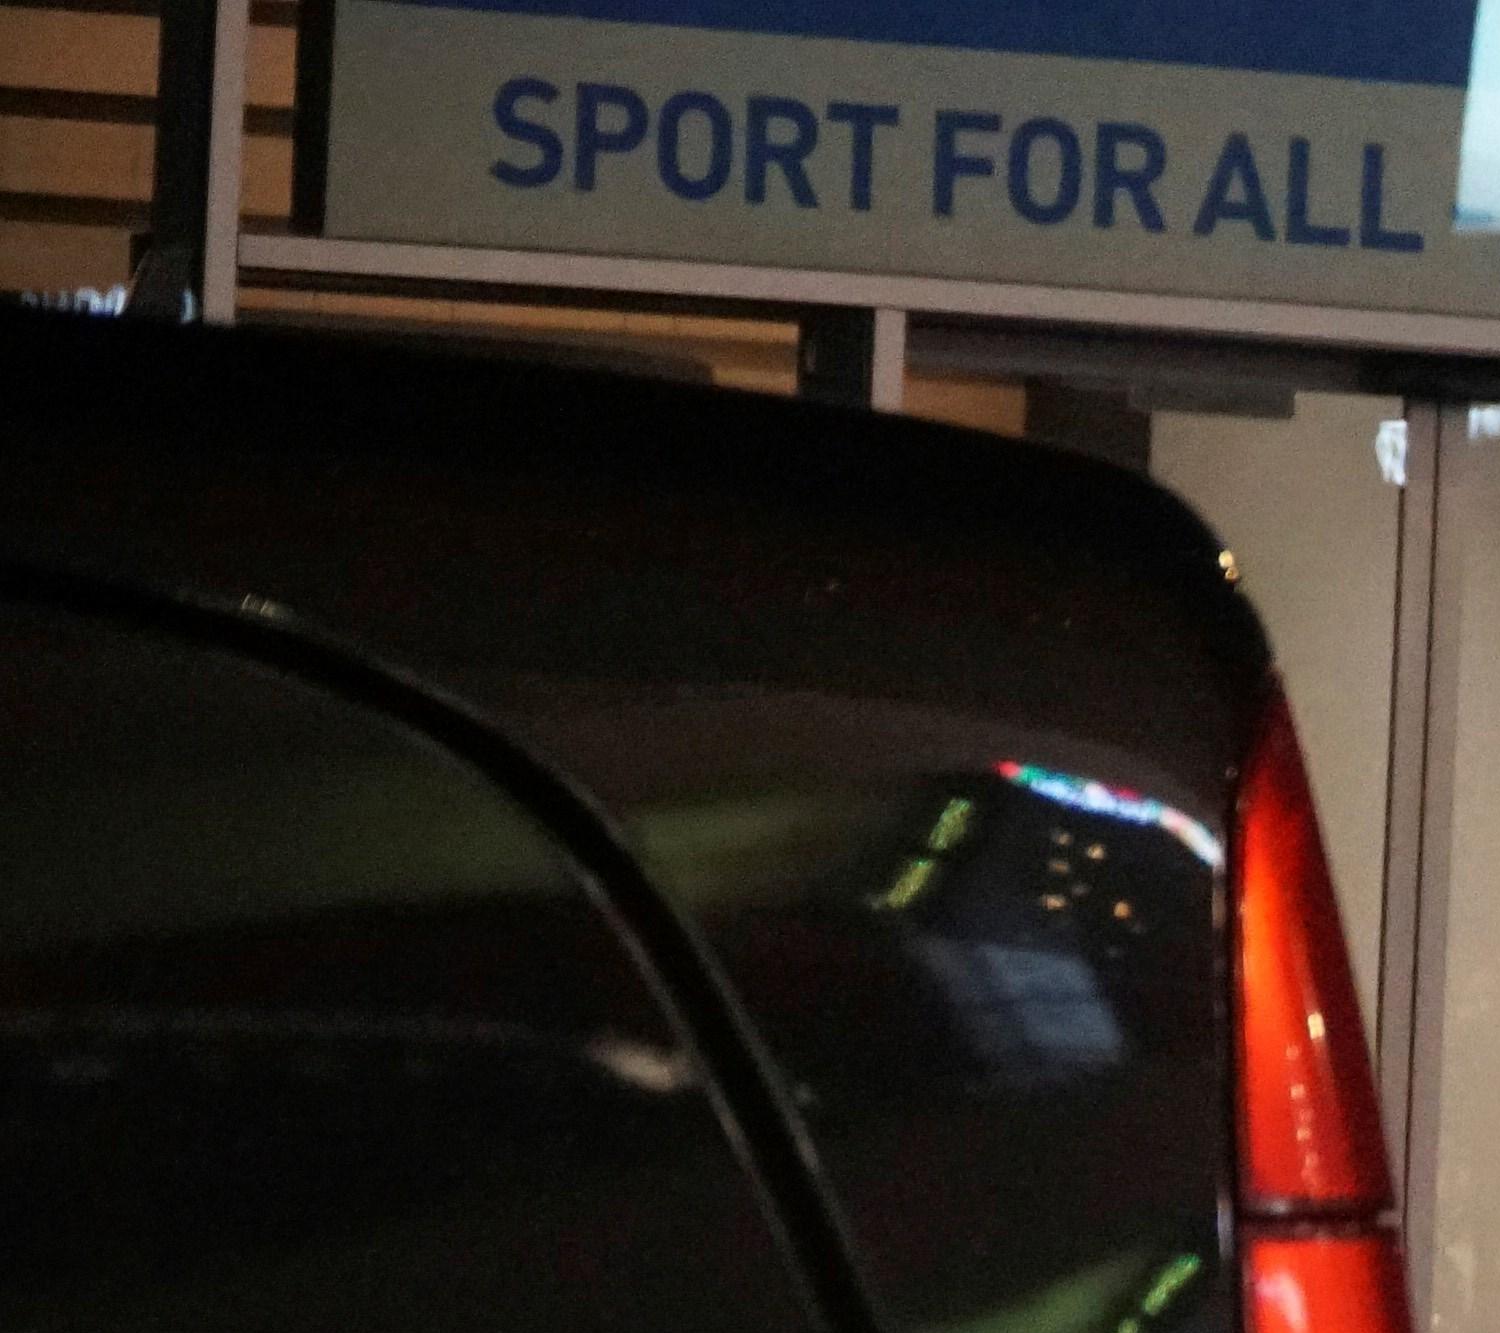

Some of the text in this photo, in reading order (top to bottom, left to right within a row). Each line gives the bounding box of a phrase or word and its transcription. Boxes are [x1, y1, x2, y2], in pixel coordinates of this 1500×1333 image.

[489, 75, 899, 211] SPORT
[932, 109, 1166, 233] FOR
[1193, 131, 1424, 253] ALL
